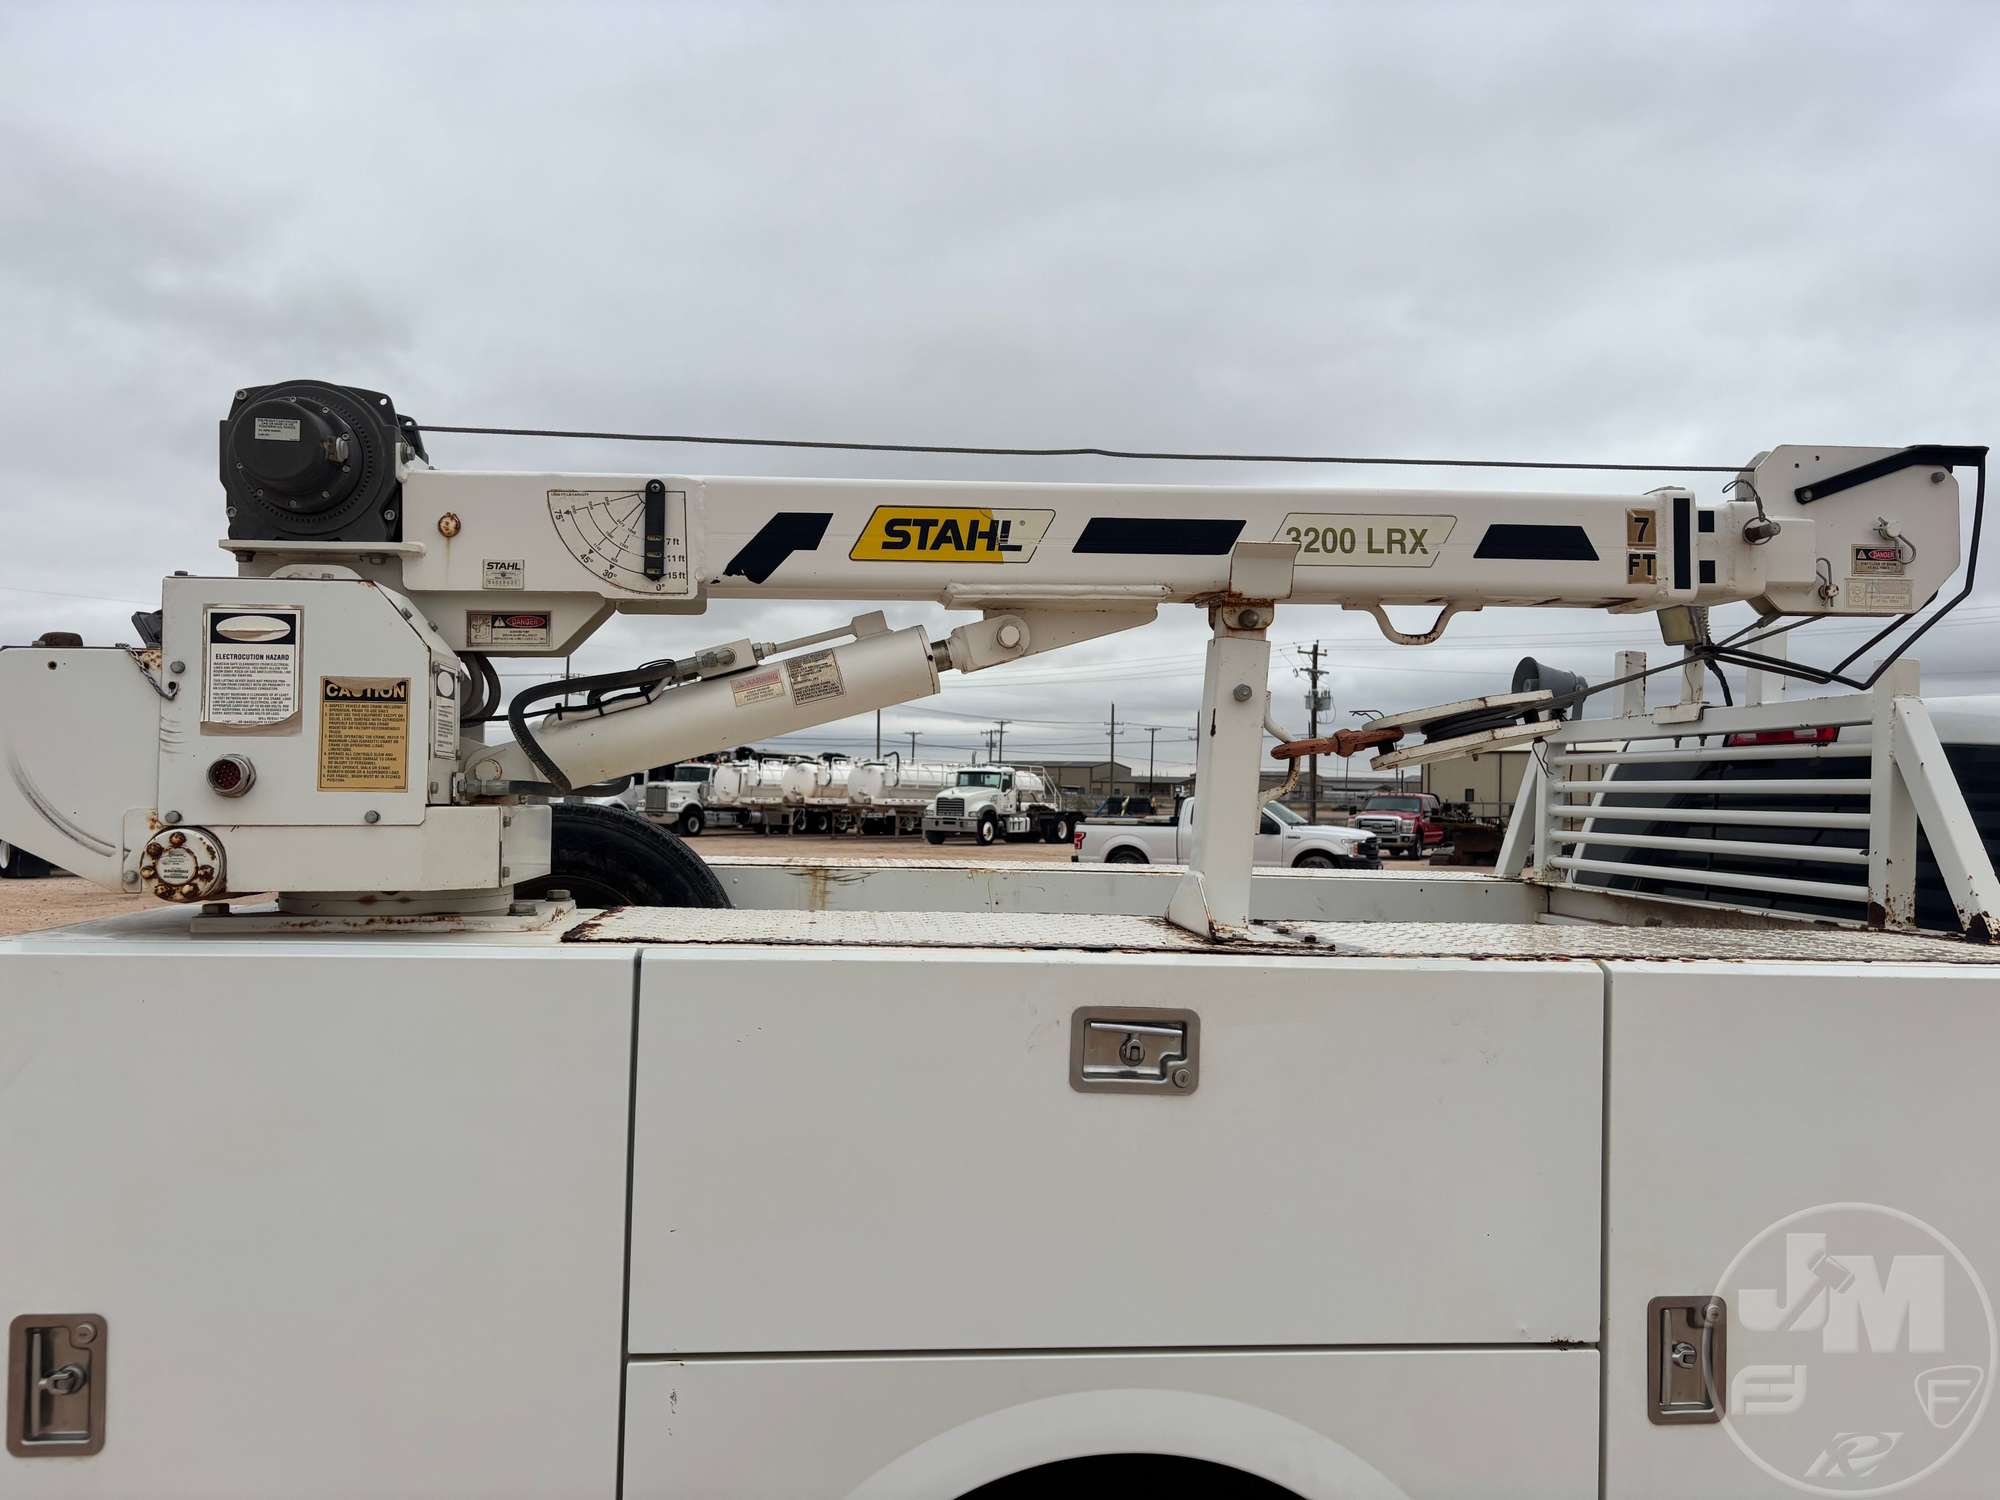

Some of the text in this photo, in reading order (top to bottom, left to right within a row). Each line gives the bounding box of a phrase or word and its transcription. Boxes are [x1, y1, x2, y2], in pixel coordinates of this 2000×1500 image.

[882, 518, 1022, 551] STAHL
[1286, 527, 1429, 554] 3200 LRX
[1633, 517, 1650, 543] 7
[487, 562, 520, 570] STAHL
[668, 571, 685, 579] 15 ft
[1628, 554, 1657, 576] FT
[215, 653, 264, 661] ELECTROCUTION
